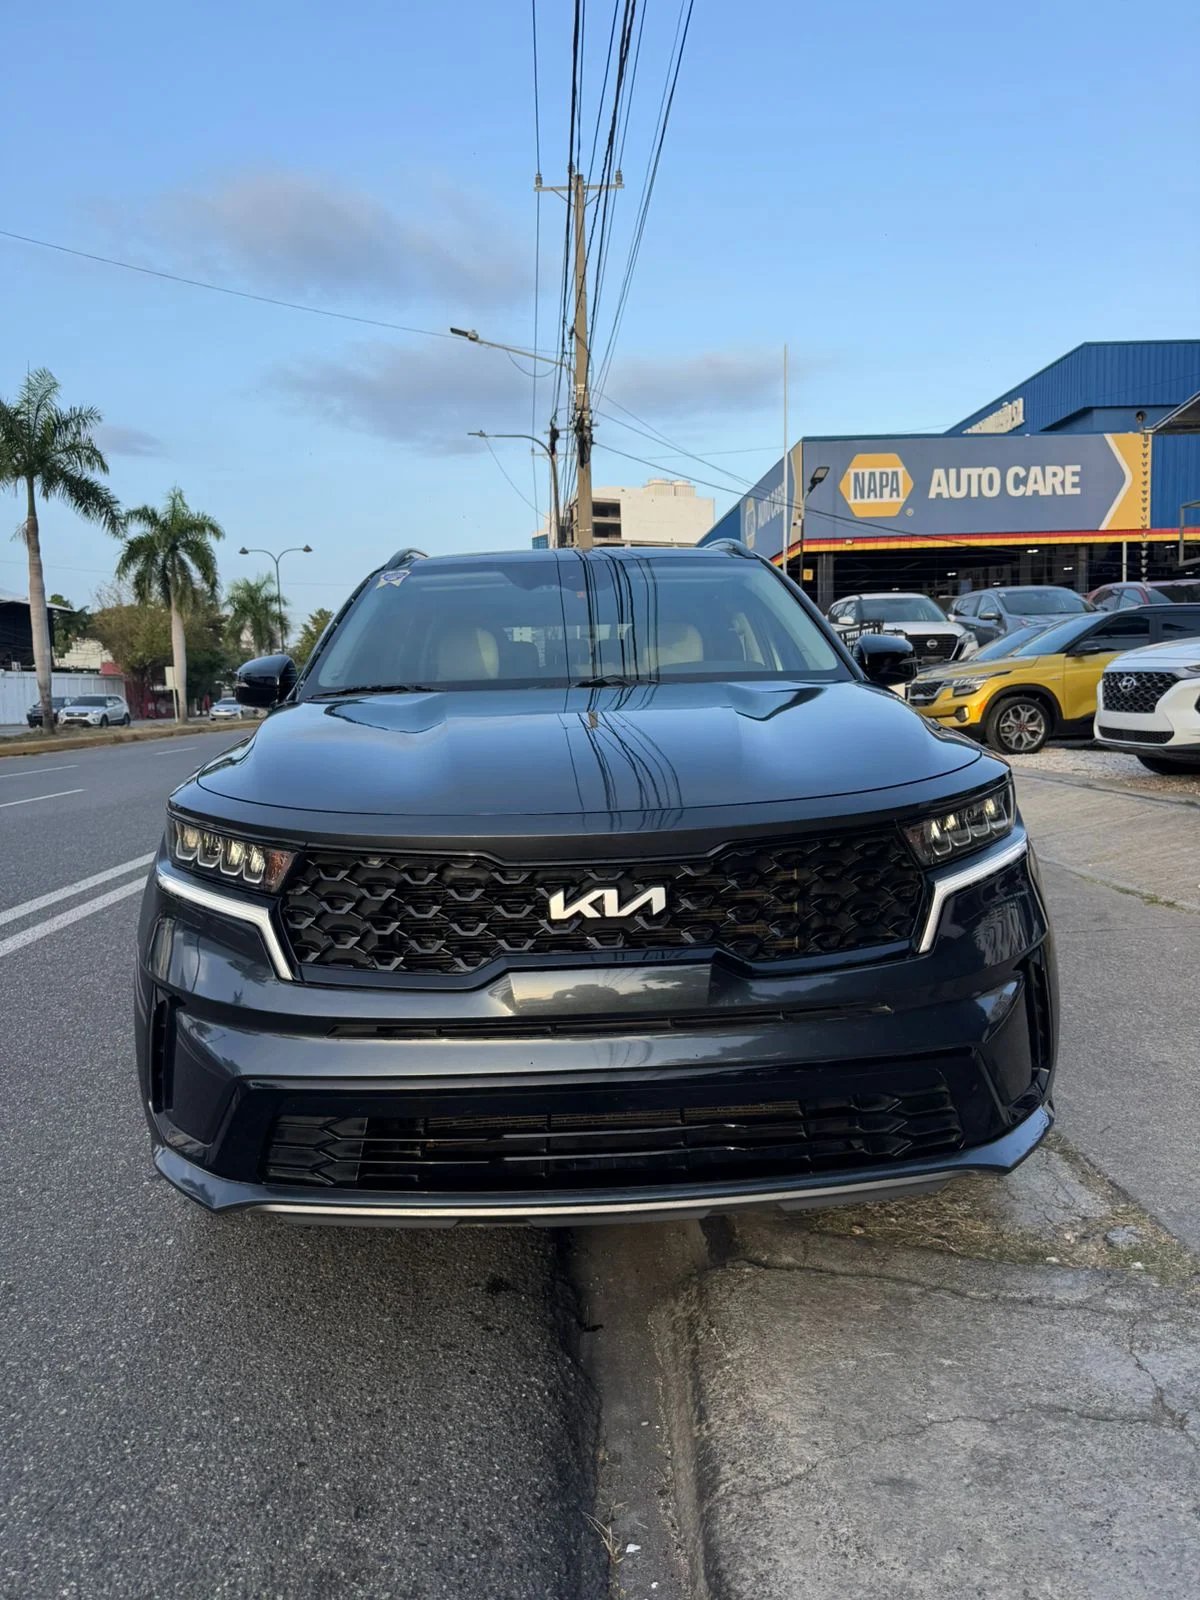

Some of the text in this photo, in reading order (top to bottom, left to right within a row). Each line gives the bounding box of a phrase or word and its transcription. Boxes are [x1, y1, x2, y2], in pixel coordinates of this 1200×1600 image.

[853, 465, 1081, 499] NAPA AUTO CARE
[549, 886, 666, 920] KIA
